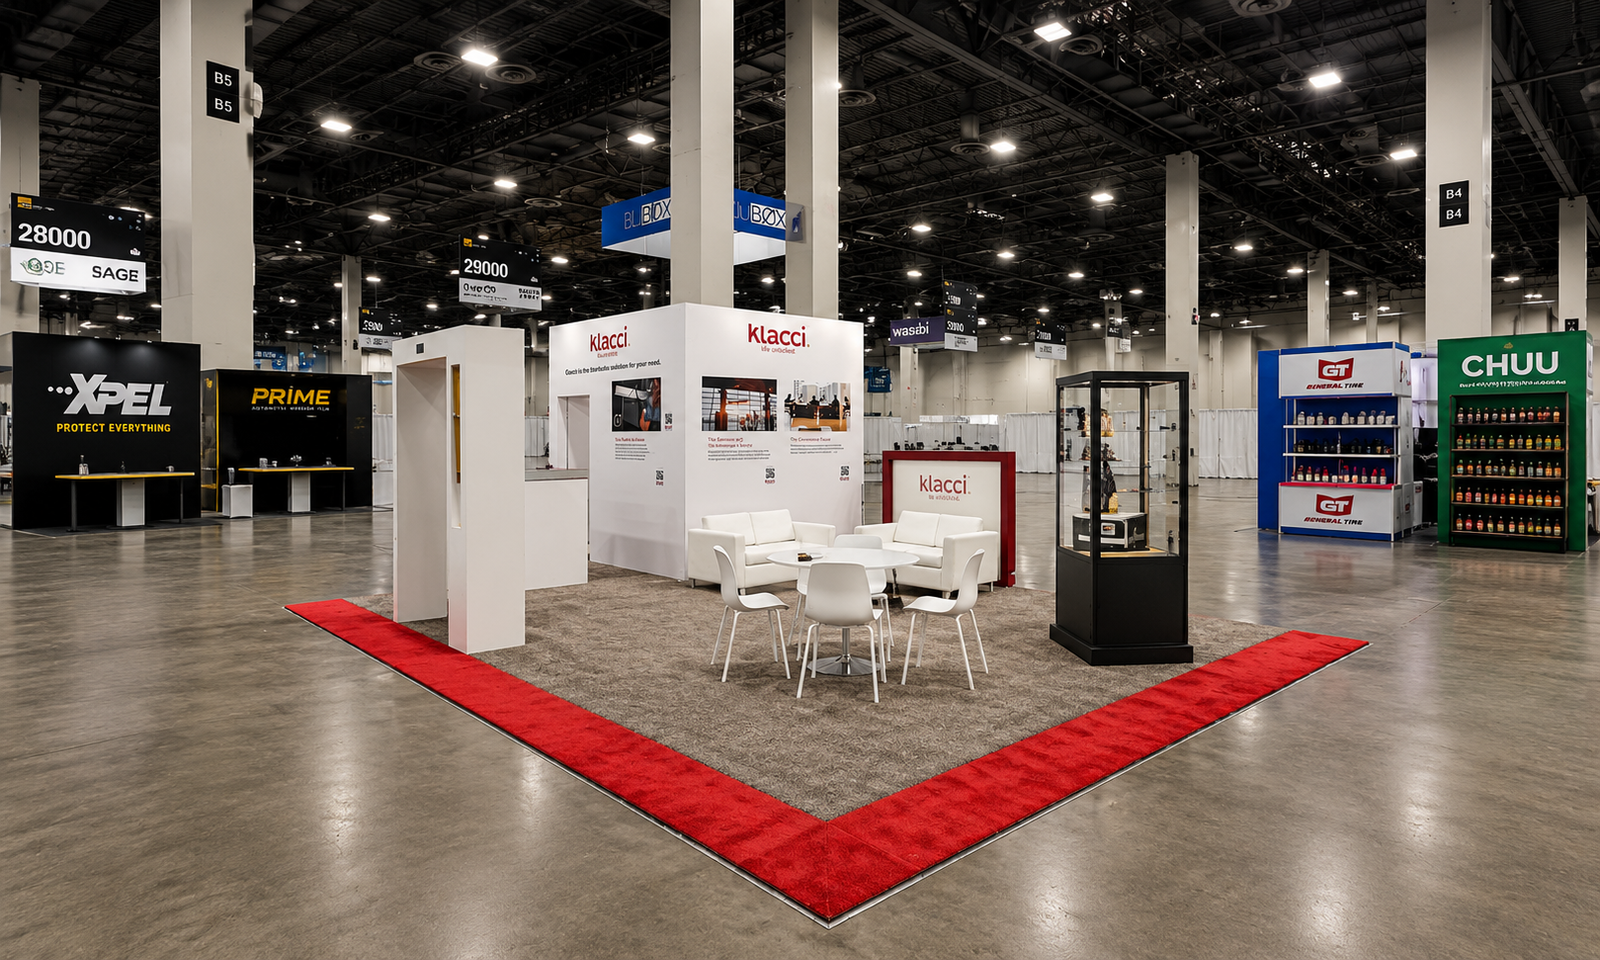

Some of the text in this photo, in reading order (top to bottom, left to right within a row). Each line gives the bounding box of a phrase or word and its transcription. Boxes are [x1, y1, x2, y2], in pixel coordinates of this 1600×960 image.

[214, 71, 232, 87] B5
[214, 97, 232, 113] B5
[1446, 187, 1462, 200] B4
[1446, 208, 1462, 220] B4
[18, 222, 91, 250] 28000
[92, 265, 139, 282] SAGE
[464, 258, 508, 278] 29000
[1322, 364, 1350, 377] GT
[1461, 351, 1559, 378] CHUU
[63, 373, 172, 416] XPEL
[251, 387, 331, 405] PRIME
[56, 423, 171, 433] PROTECT EVERYTHING
[1320, 500, 1349, 513] GT
